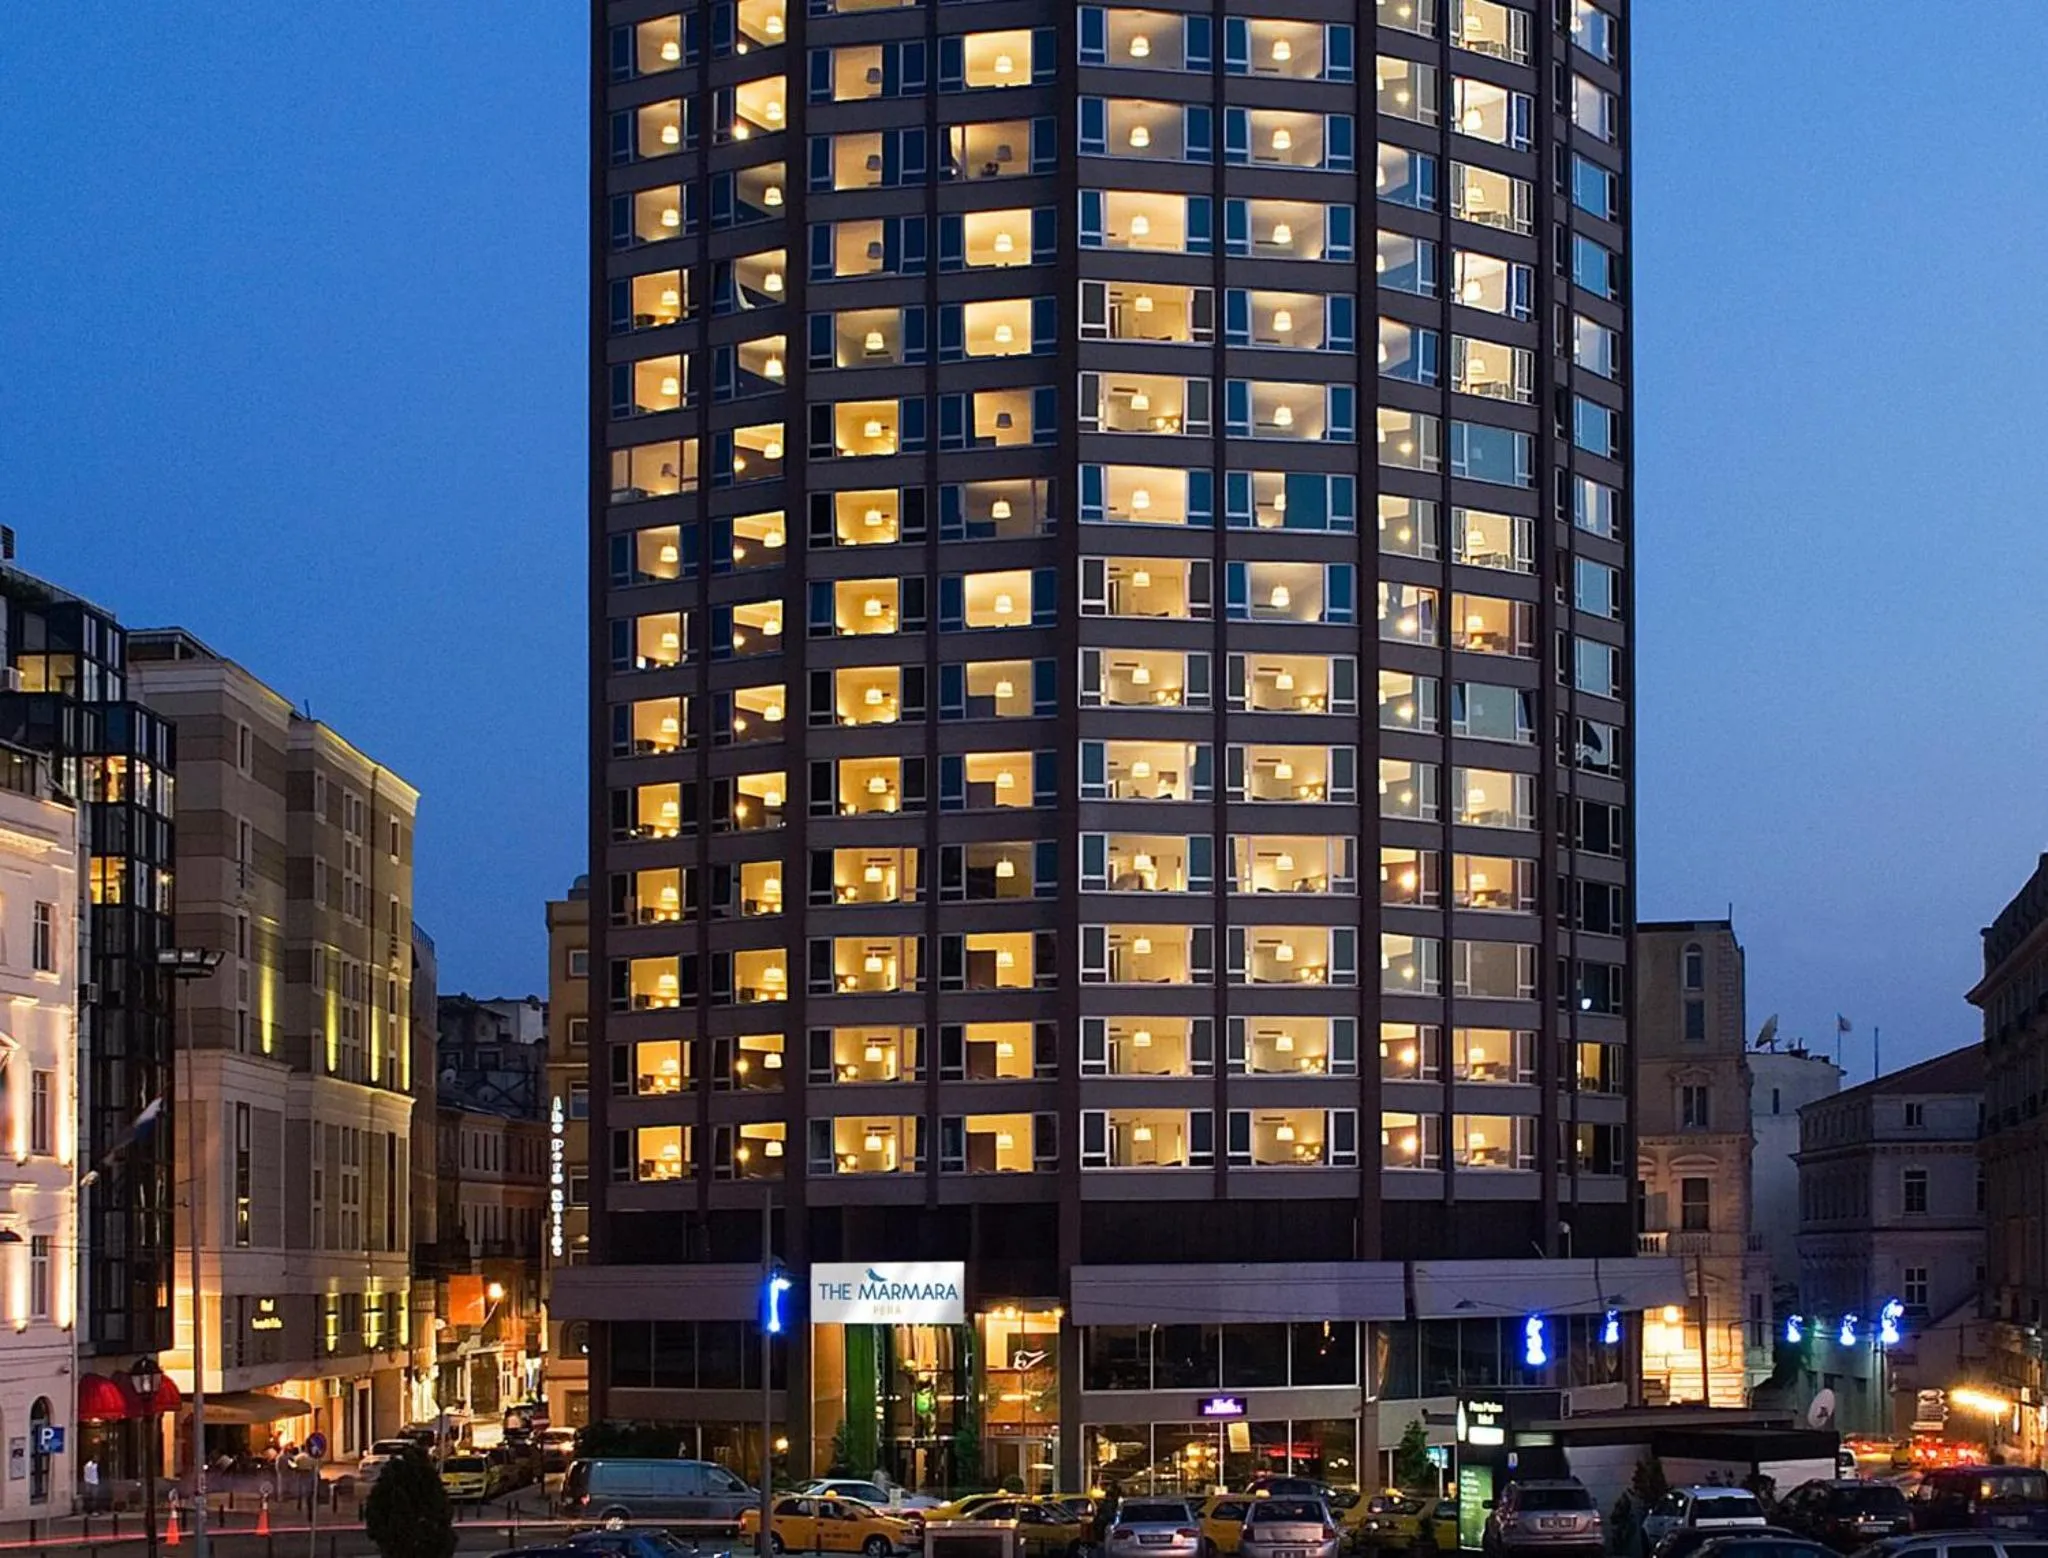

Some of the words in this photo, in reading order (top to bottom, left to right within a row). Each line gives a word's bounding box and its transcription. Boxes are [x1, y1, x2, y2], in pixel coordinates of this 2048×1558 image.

[819, 1283, 851, 1300] THE
[858, 1283, 958, 1300] MARMARA
[873, 1305, 901, 1315] PERA
[41, 1428, 54, 1445] P
